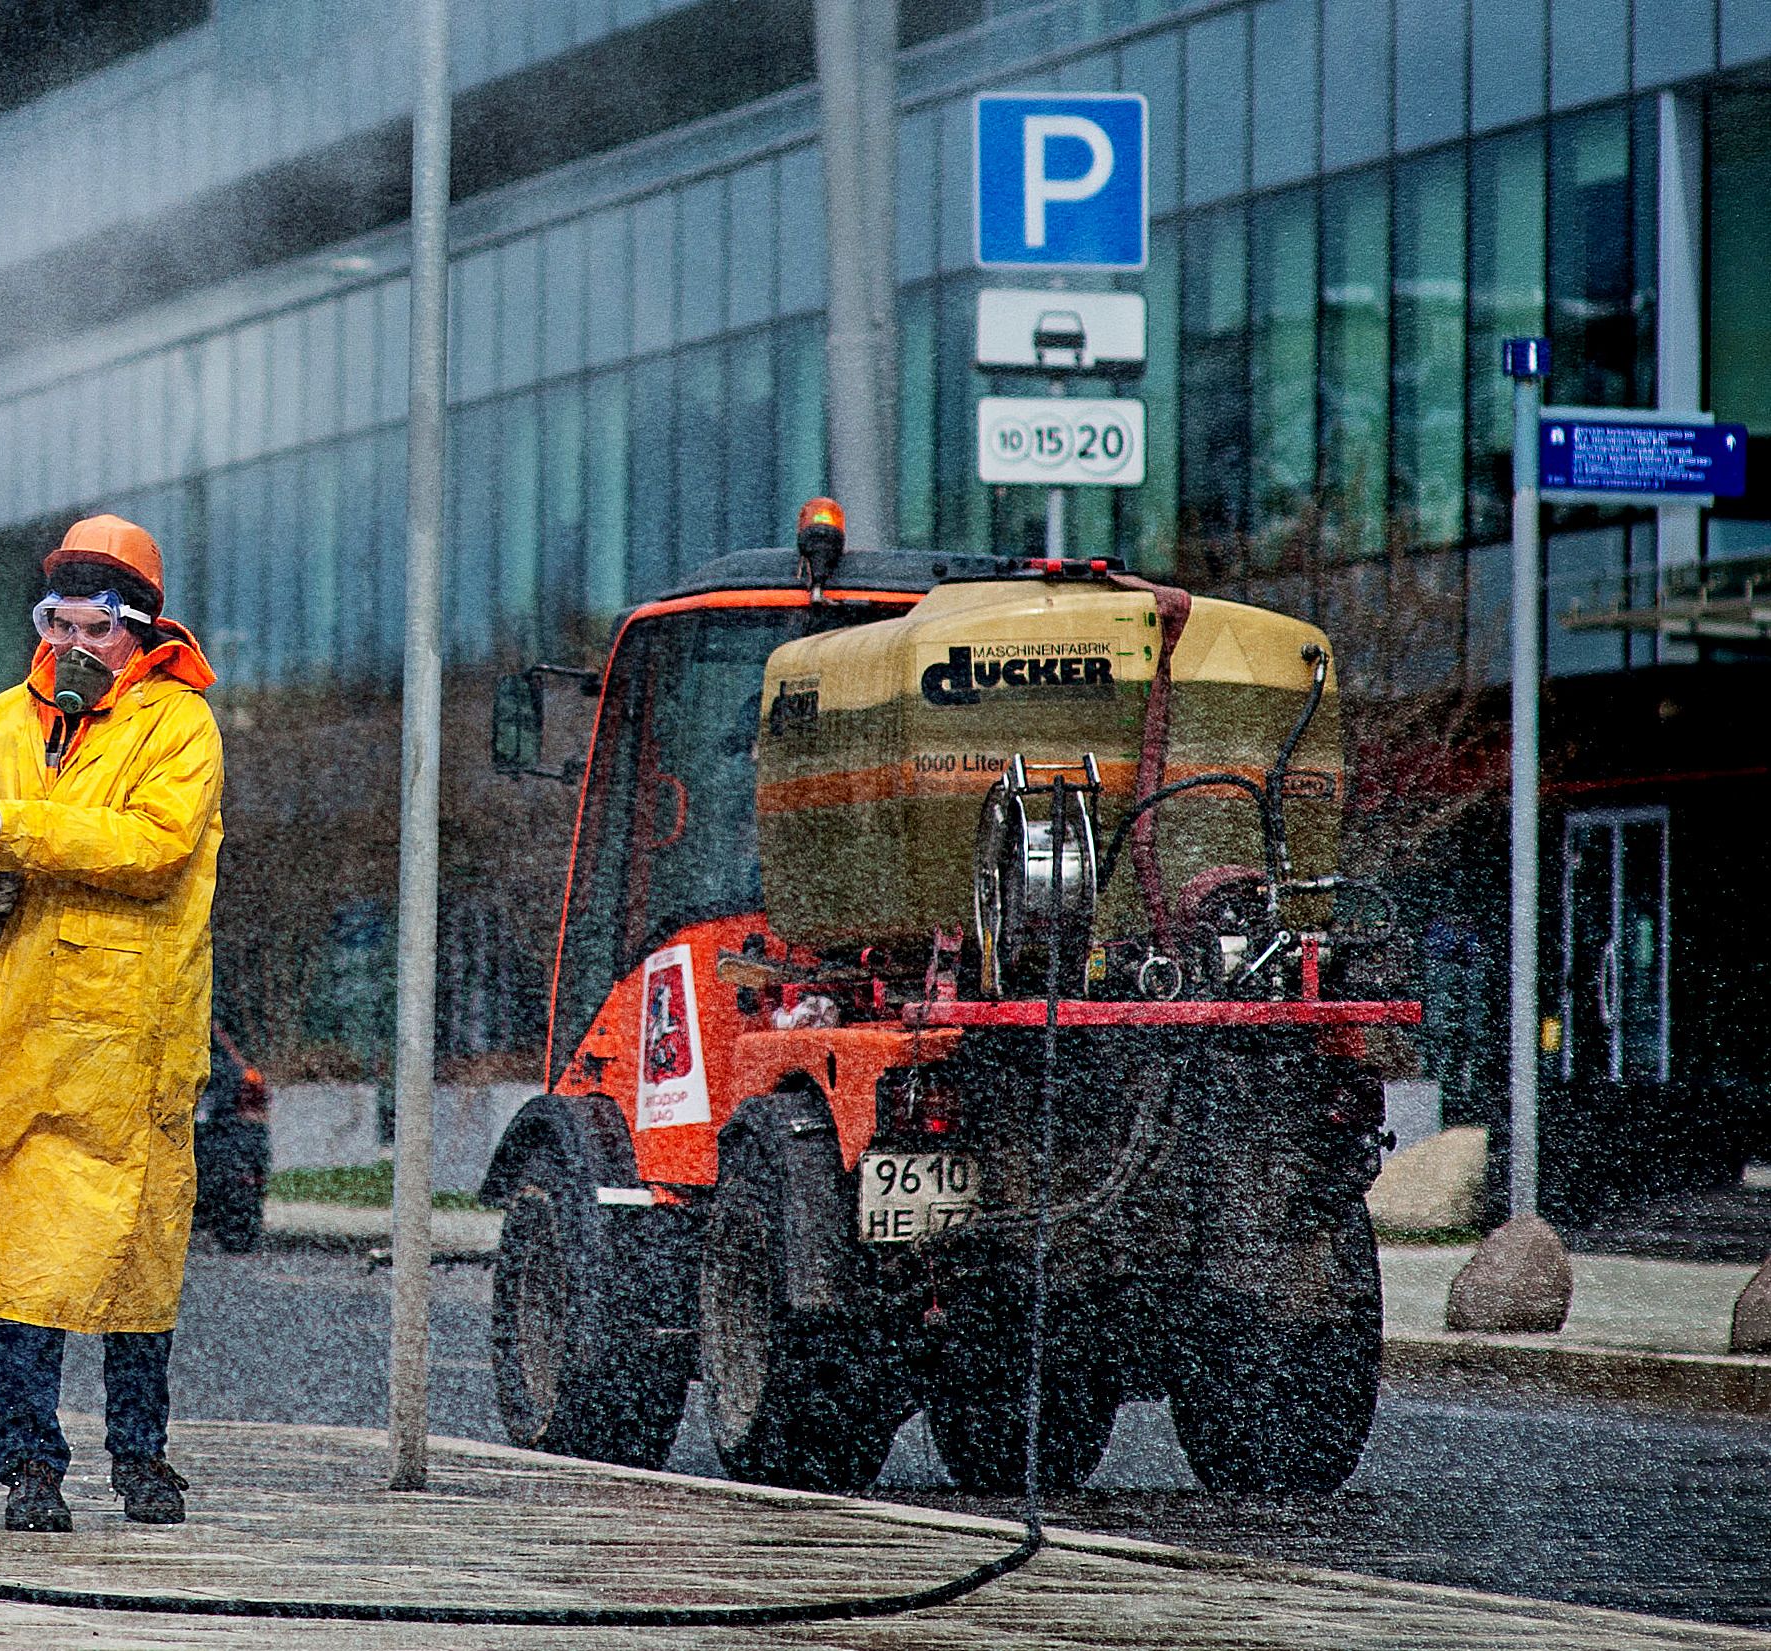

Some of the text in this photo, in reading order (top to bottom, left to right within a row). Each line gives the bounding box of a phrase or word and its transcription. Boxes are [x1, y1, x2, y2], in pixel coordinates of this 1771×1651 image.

[1024, 115, 1114, 248] P
[998, 425, 1124, 460] 10 15 20
[973, 643, 1111, 659] MASCHINENFABRIK
[914, 753, 1004, 773] 1000 Liter
[876, 1157, 968, 1195] 9610
